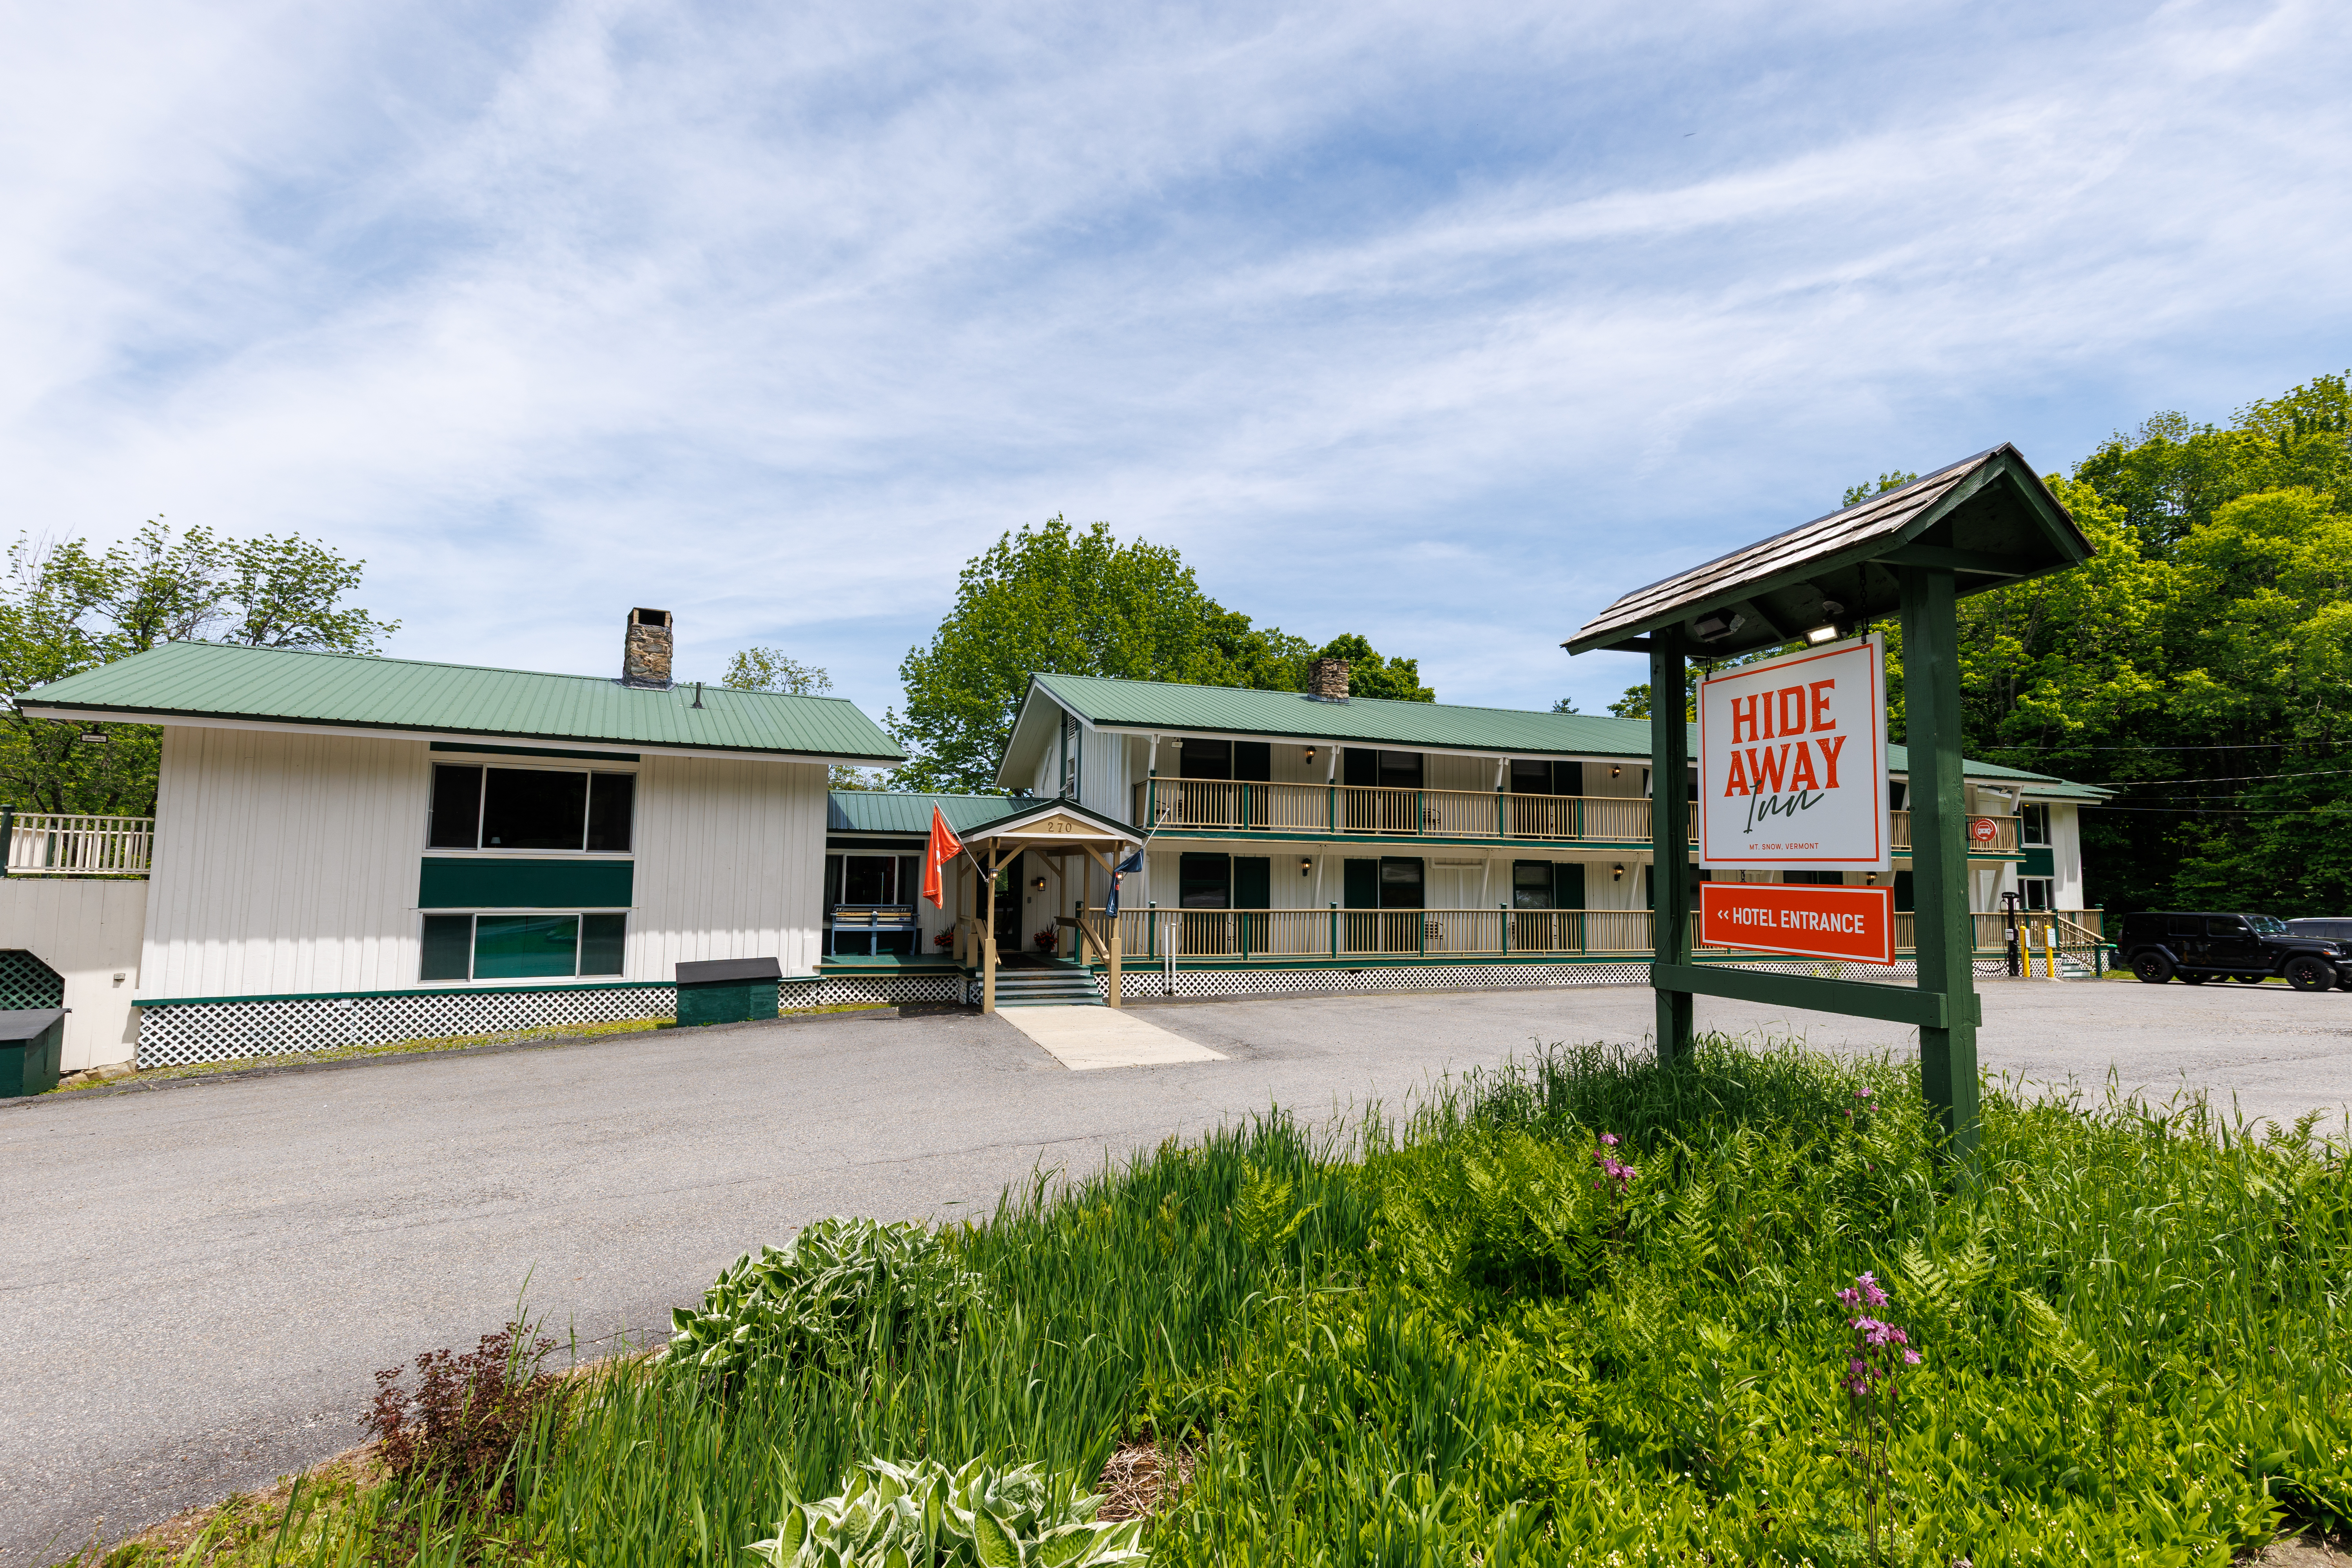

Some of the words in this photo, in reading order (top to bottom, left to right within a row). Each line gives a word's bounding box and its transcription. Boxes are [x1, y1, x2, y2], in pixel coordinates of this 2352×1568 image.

[1731, 679, 1836, 744] HIDE
[1724, 735, 1847, 797] AWAY
[1048, 821, 1072, 832] 270
[1743, 779, 1824, 834] Inn
[1733, 907, 1777, 927] HOTEL
[1781, 910, 1865, 934] ENTRANCE
